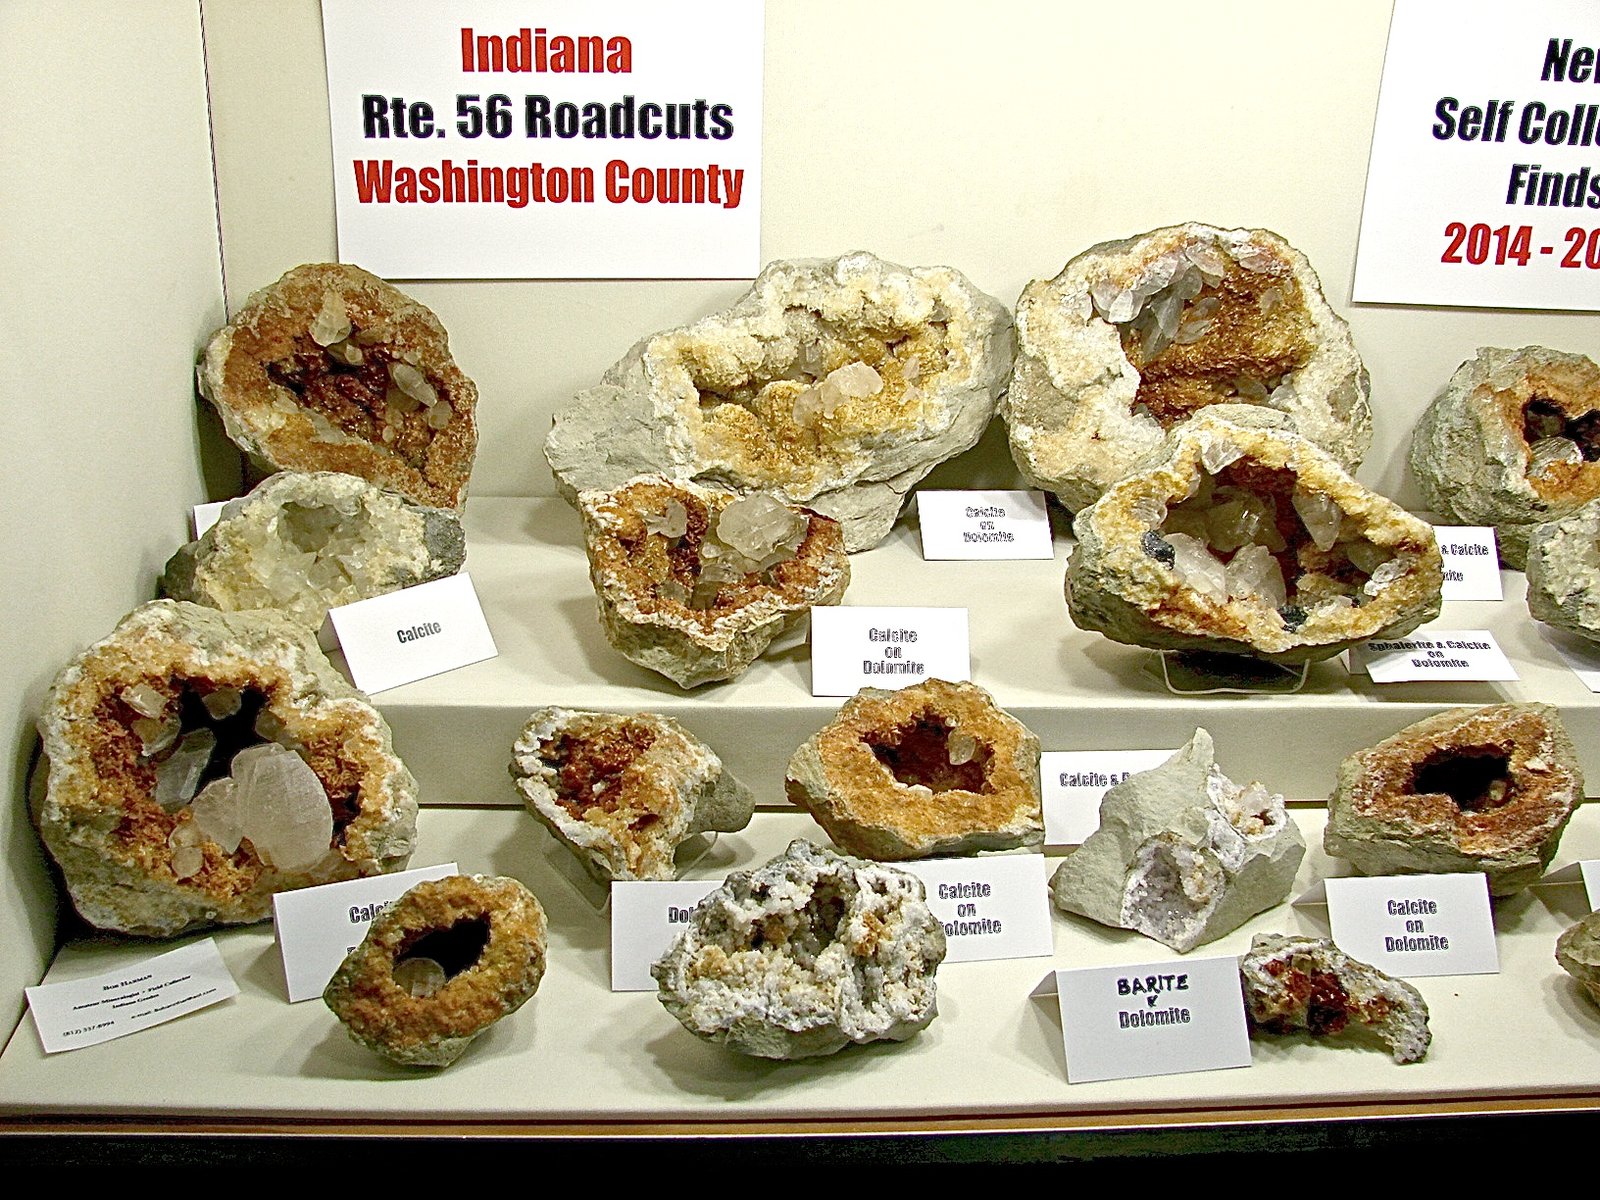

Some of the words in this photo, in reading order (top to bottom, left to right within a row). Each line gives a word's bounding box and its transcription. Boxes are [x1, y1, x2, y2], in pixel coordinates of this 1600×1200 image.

[461, 28, 631, 74] Indiana
[1541, 38, 1600, 83] Ne
[362, 94, 445, 138] Rte.
[456, 94, 512, 138] 56
[525, 95, 733, 140] Roadcuts
[1433, 97, 1515, 142] Self
[1519, 102, 1600, 146] Coll
[353, 160, 594, 208] Washington
[606, 160, 744, 208] County
[1441, 222, 1533, 266] 2014
[1540, 246, 1554, 255] -
[1451, 544, 1488, 555] Calcite
[397, 623, 441, 643] Calcite
[869, 628, 917, 642] Calcite
[885, 647, 901, 658] on
[1448, 641, 1490, 649] Calcite
[864, 661, 924, 674] Dolomite
[1412, 659, 1469, 667] Dolomite
[1060, 772, 1107, 786] Calcite
[1110, 774, 1119, 787] &
[939, 882, 990, 899] Calcite
[958, 904, 976, 917] on
[1388, 899, 1437, 915] Calcite
[940, 918, 1002, 937] olomite
[1406, 920, 1424, 933] on
[1385, 935, 1448, 952] Dolomite
[1117, 974, 1189, 996] BARITE
[1119, 1006, 1190, 1028] Dolomite
